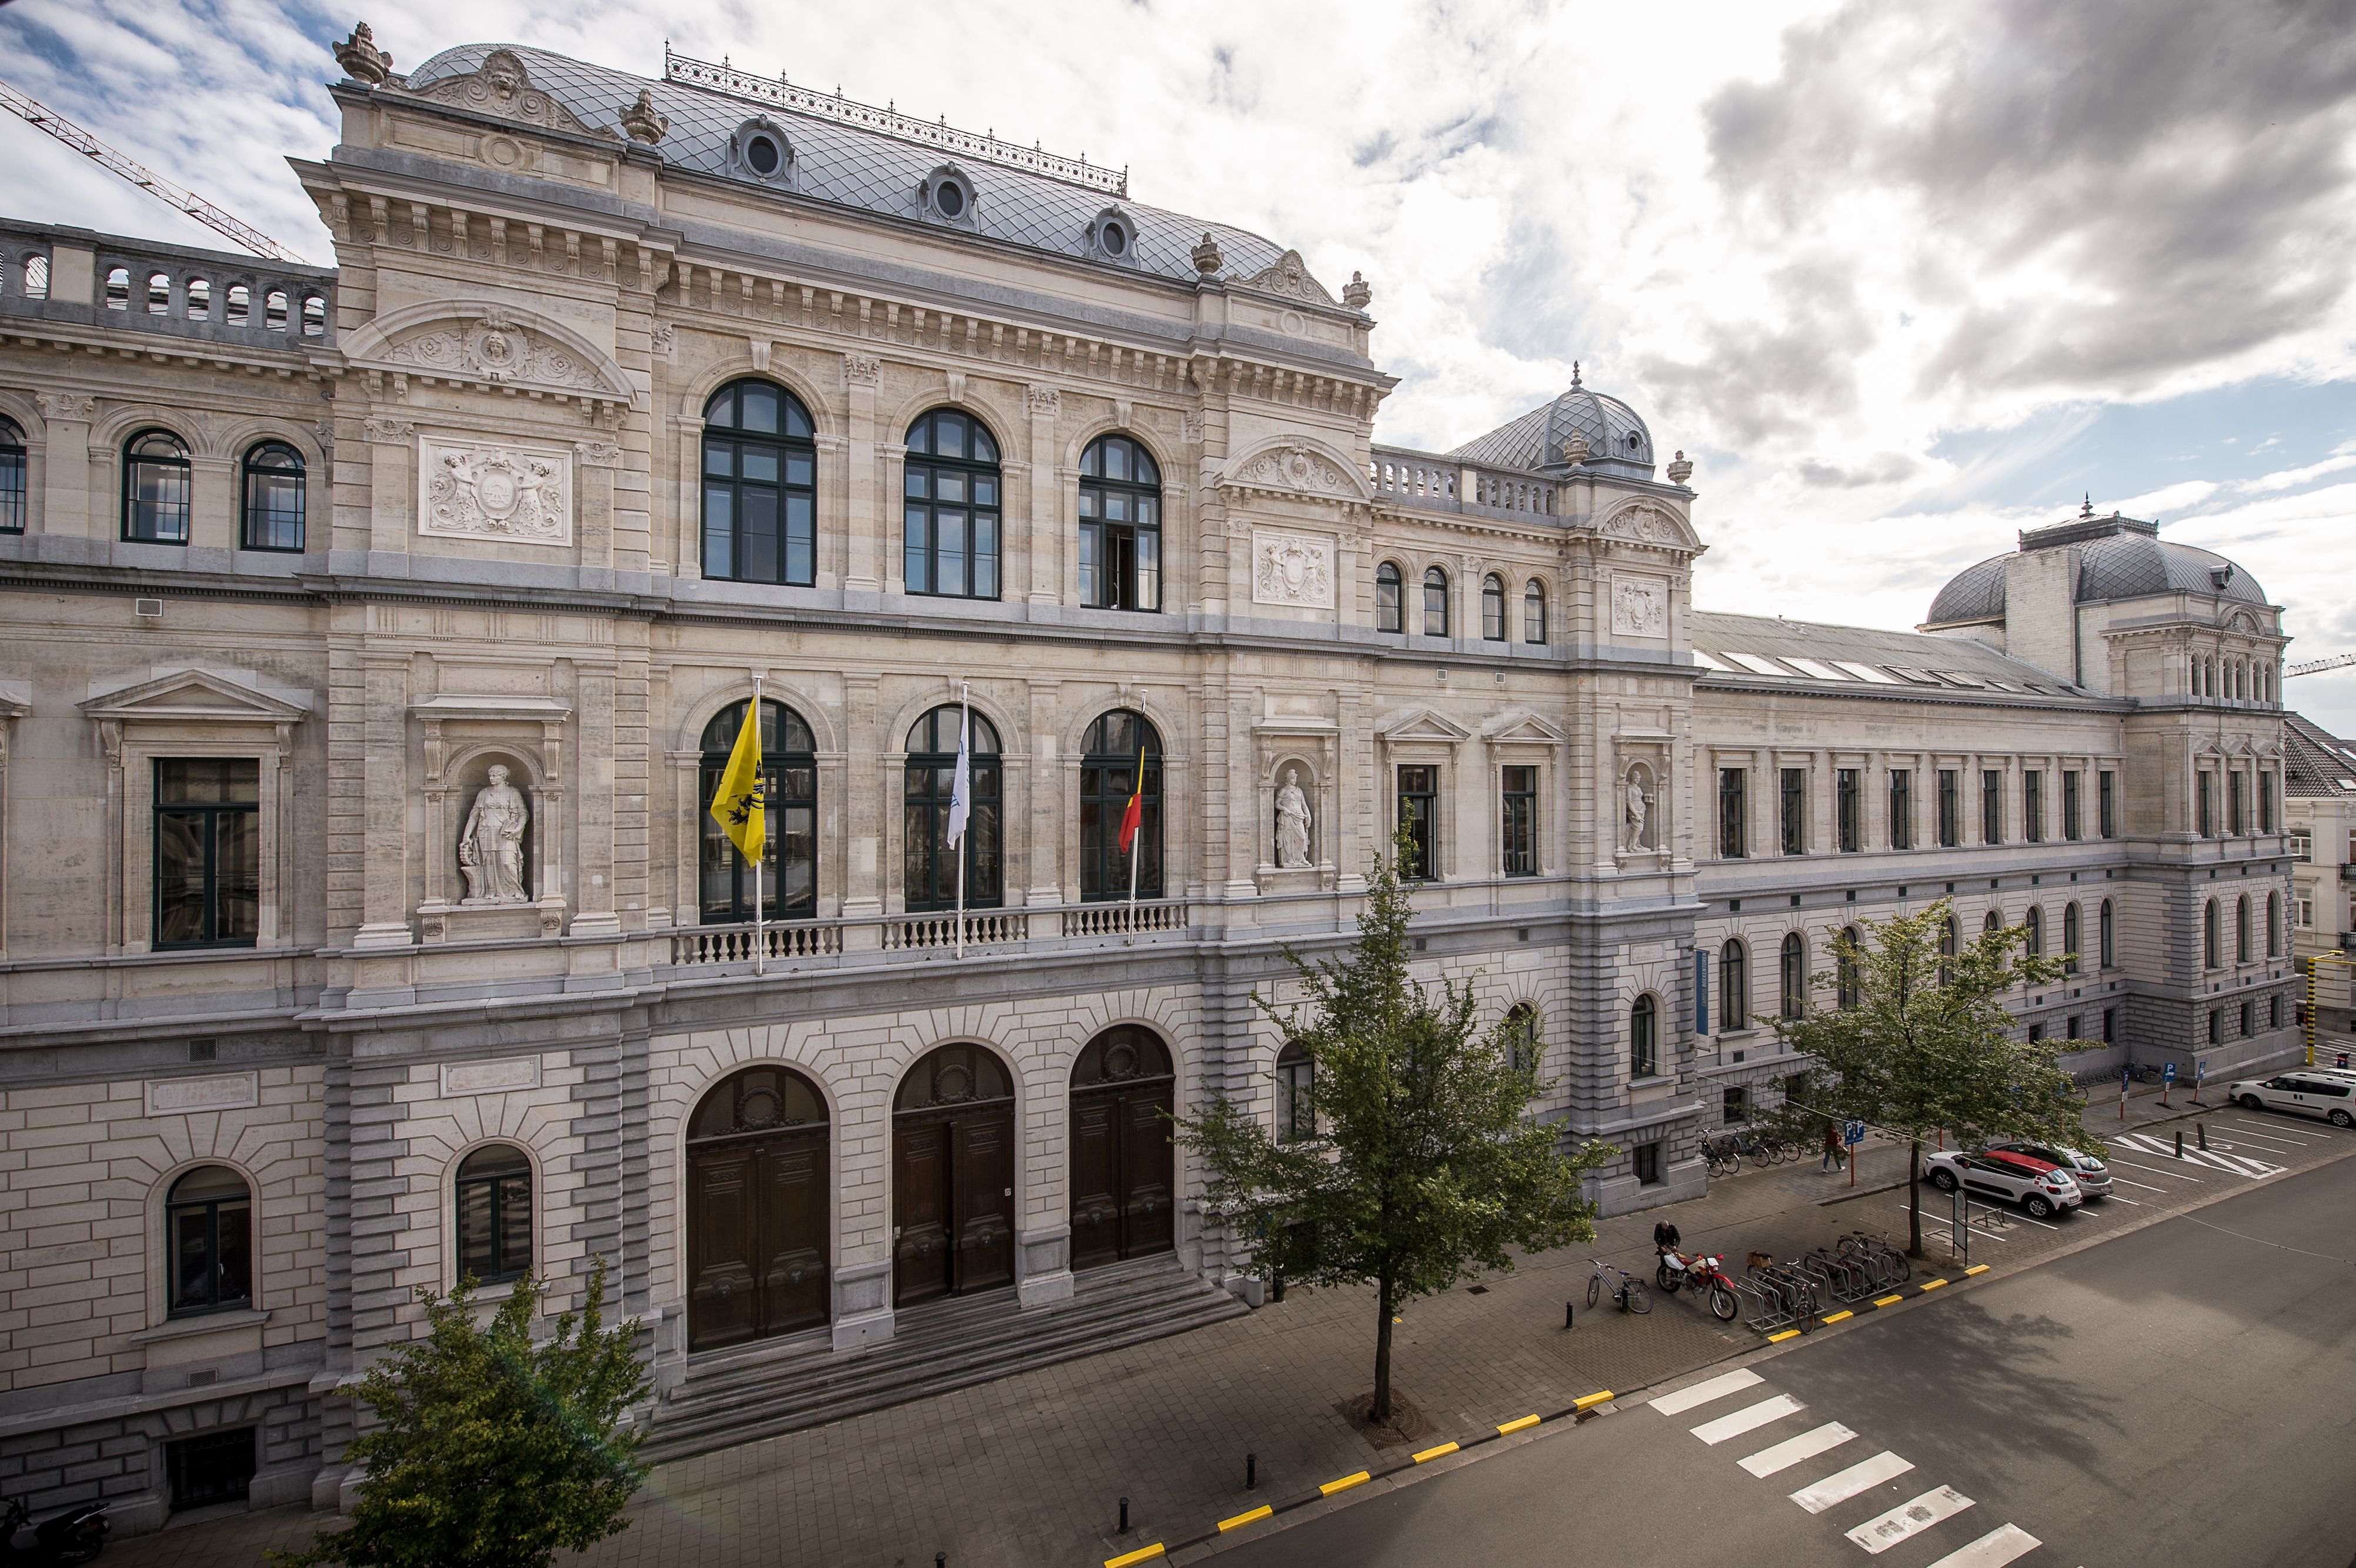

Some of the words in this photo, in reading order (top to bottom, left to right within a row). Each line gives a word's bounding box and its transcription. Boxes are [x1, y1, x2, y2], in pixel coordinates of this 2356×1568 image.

[2124, 1074, 2128, 1085] P
[1846, 1123, 1853, 1136] P
[1857, 1120, 1863, 1134] P
